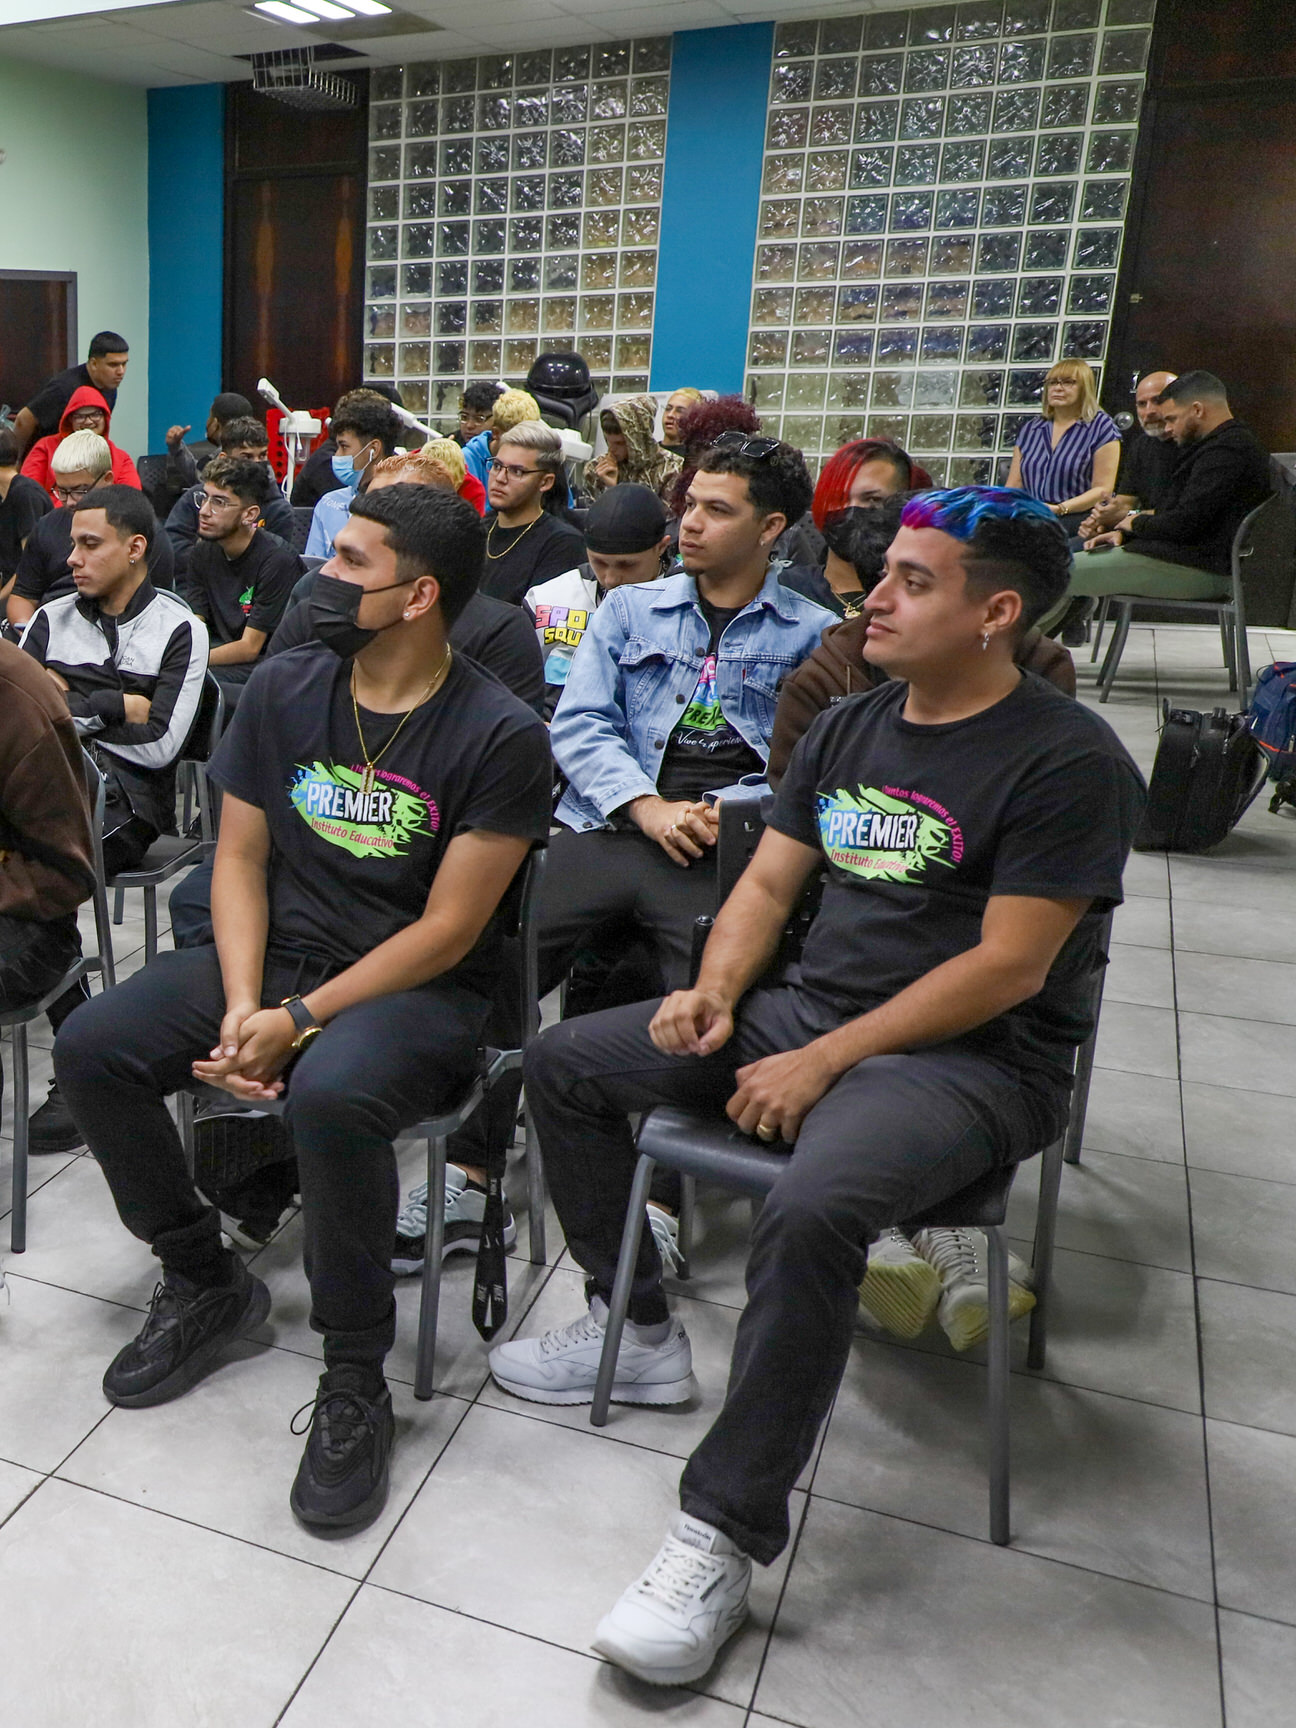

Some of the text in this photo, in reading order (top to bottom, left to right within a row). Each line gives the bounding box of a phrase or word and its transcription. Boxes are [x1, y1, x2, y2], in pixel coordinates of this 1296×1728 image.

[535, 605, 593, 630] SPO
[380, 767, 421, 794] lograremos
[419, 789, 431, 801] el
[307, 783, 392, 822] PREMIER
[311, 817, 394, 849] Instituto Educativo
[828, 812, 917, 848] PREMIER
[945, 817, 958, 827] el
[830, 849, 874, 868] Instituto
[950, 827, 964, 863] EXITO!
